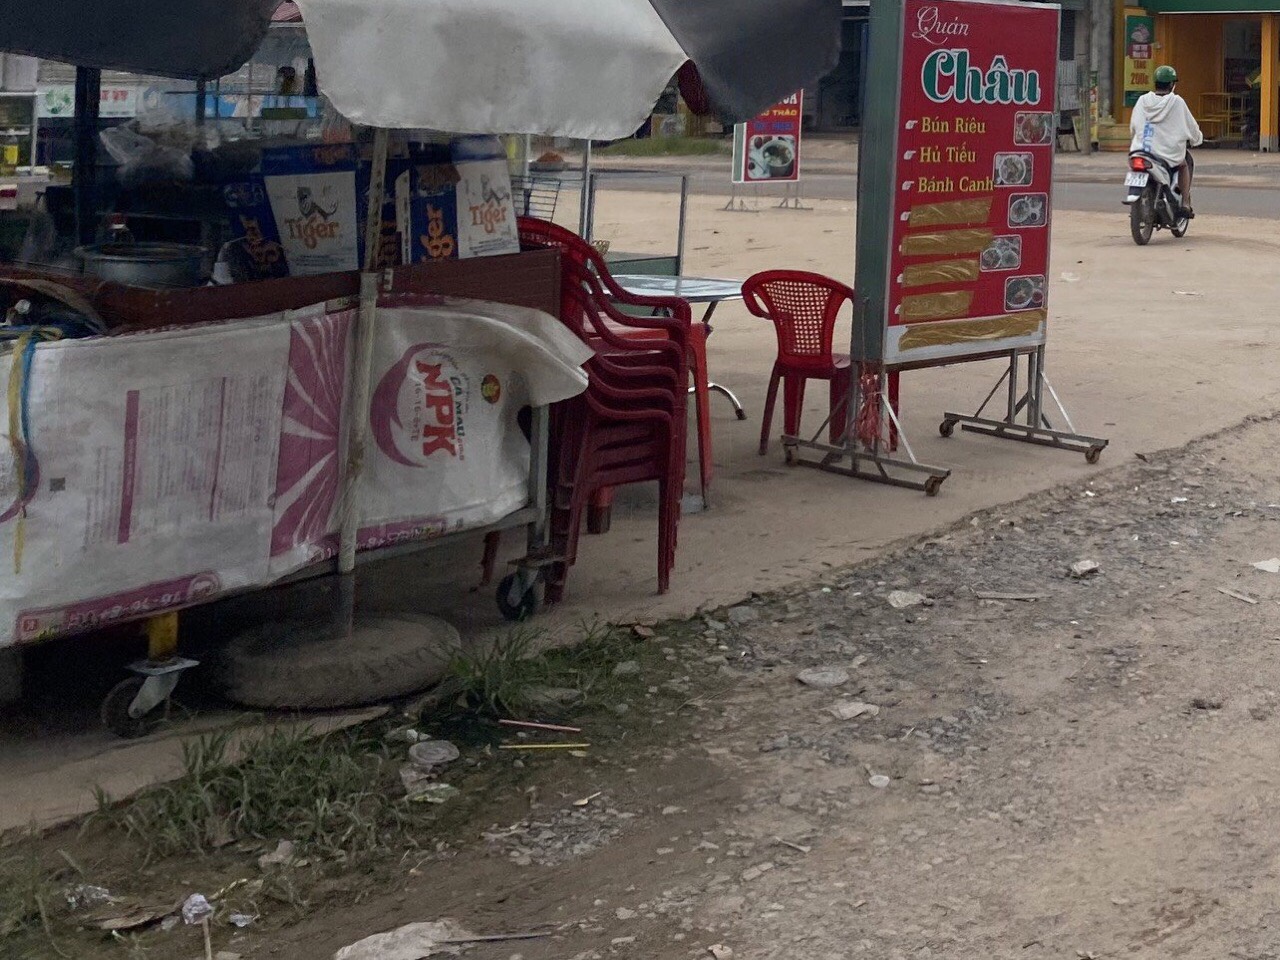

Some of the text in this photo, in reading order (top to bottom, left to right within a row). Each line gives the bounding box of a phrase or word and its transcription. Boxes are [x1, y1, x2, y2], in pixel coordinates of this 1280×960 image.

[921, 48, 1041, 106] Châu
[920, 116, 986, 134] Bún Riêu
[919, 145, 941, 163] Hủ
[918, 176, 995, 192] Bánh Canh
[284, 215, 340, 250] Tiger
[469, 201, 507, 234] Tiger
[415, 360, 457, 457] NPK
